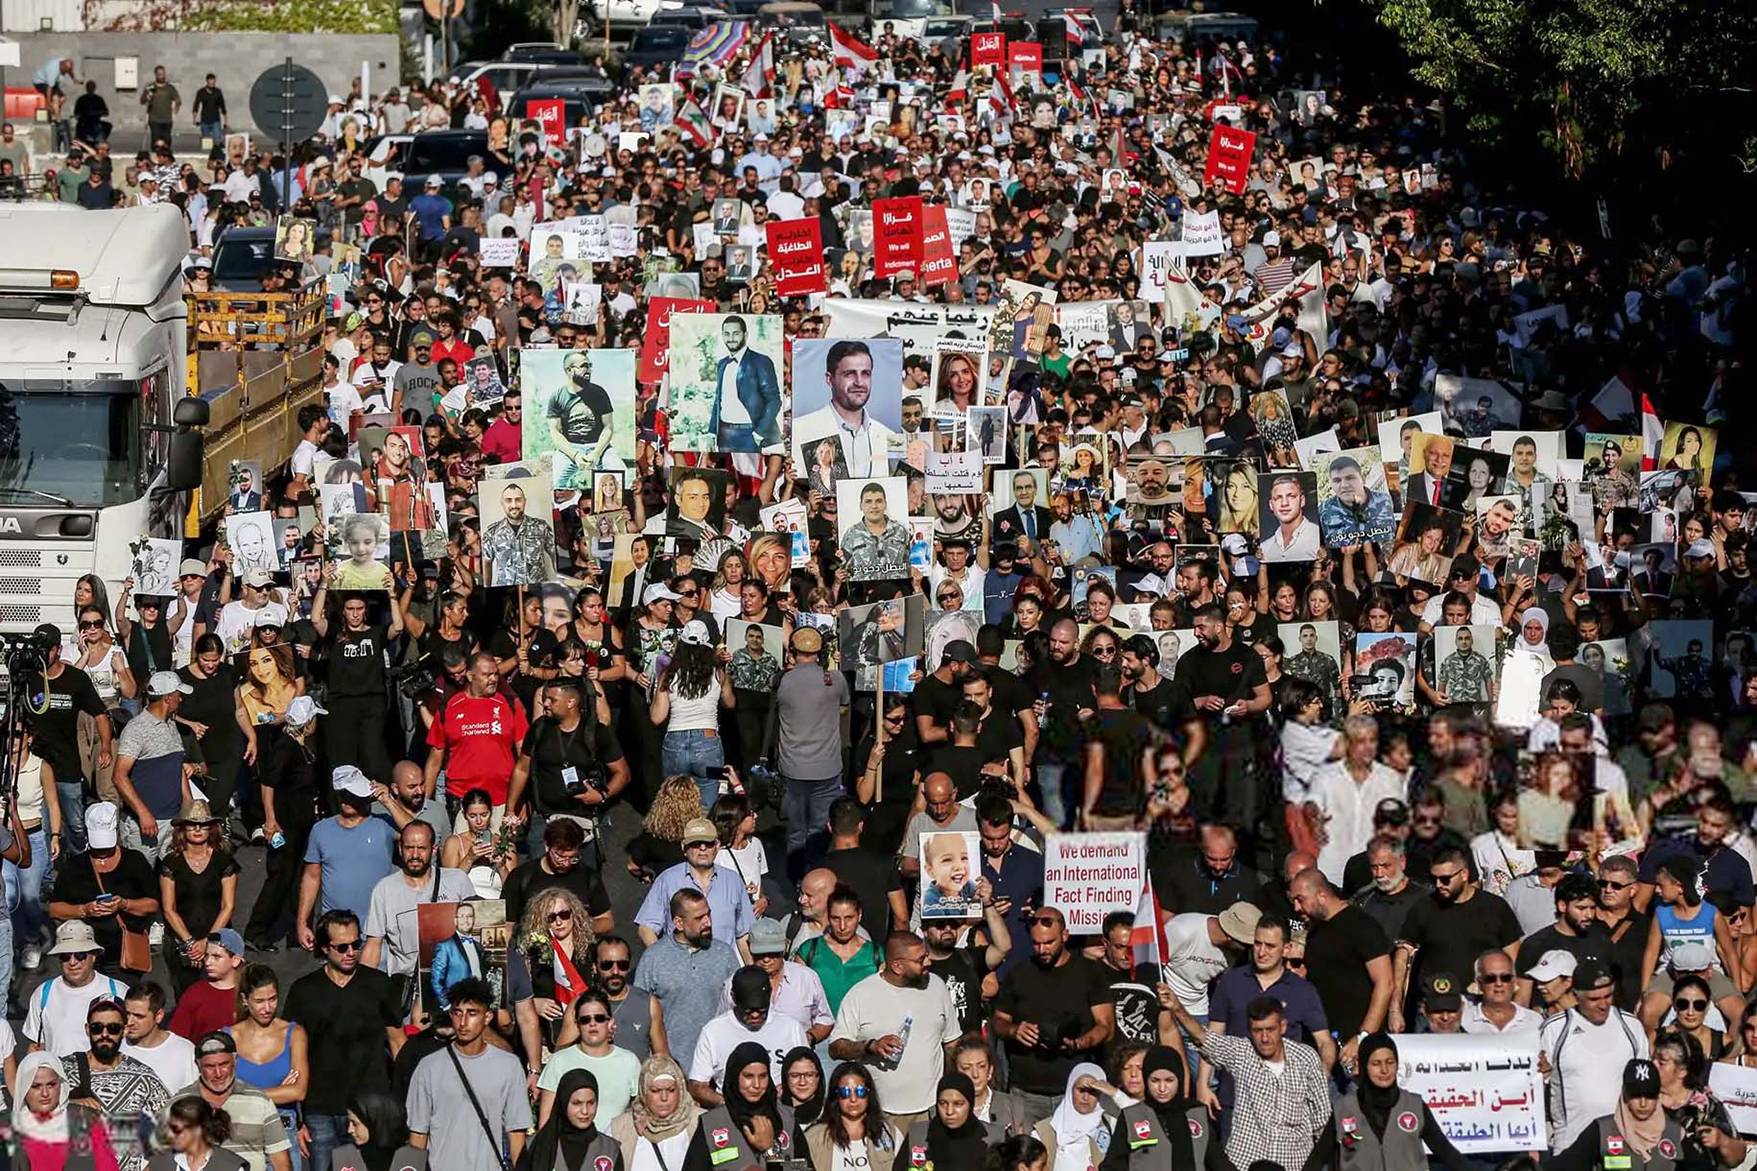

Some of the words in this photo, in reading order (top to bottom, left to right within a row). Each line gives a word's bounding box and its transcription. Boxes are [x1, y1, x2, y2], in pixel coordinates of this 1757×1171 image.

[776, 264, 820, 281] العدل
[1059, 843, 1078, 859] We
[1080, 842, 1128, 858] demand
[1046, 868, 1060, 881] an
[1055, 887, 1082, 903] Fact
[1086, 886, 1132, 906] Finding
[1427, 1088, 1484, 1114] الحقيقة
[1491, 1083, 1535, 1112] أين
[1442, 1121, 1501, 1147] الطبقة
[1508, 1116, 1536, 1146] أيها
[844, 1157, 867, 1168] NO
